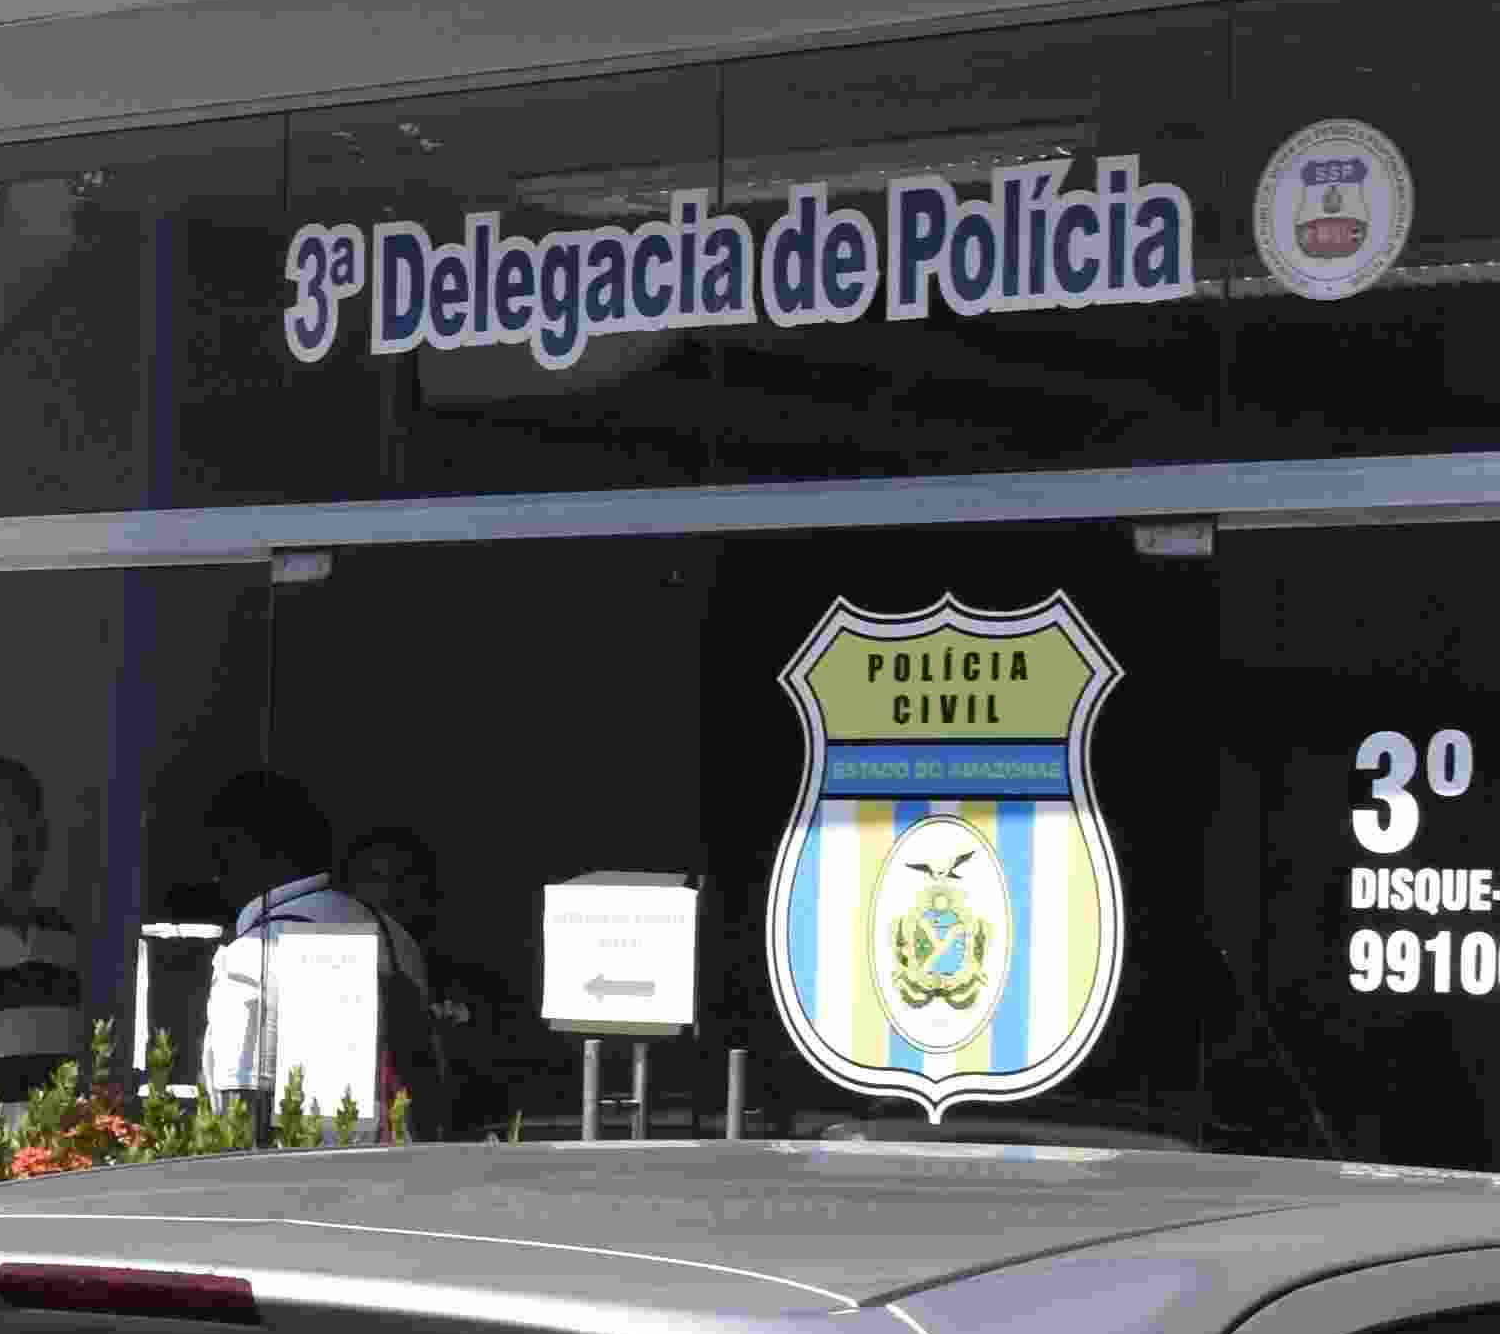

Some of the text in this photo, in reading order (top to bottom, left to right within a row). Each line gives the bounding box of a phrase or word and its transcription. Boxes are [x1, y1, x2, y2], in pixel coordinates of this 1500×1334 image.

[375, 194, 749, 363] Delegacia
[772, 191, 871, 319] de
[893, 164, 1187, 313] Polícia
[867, 645, 1029, 683] POLÍCIA
[892, 693, 1001, 725] CIVIL
[1348, 928, 1500, 996] 9910
